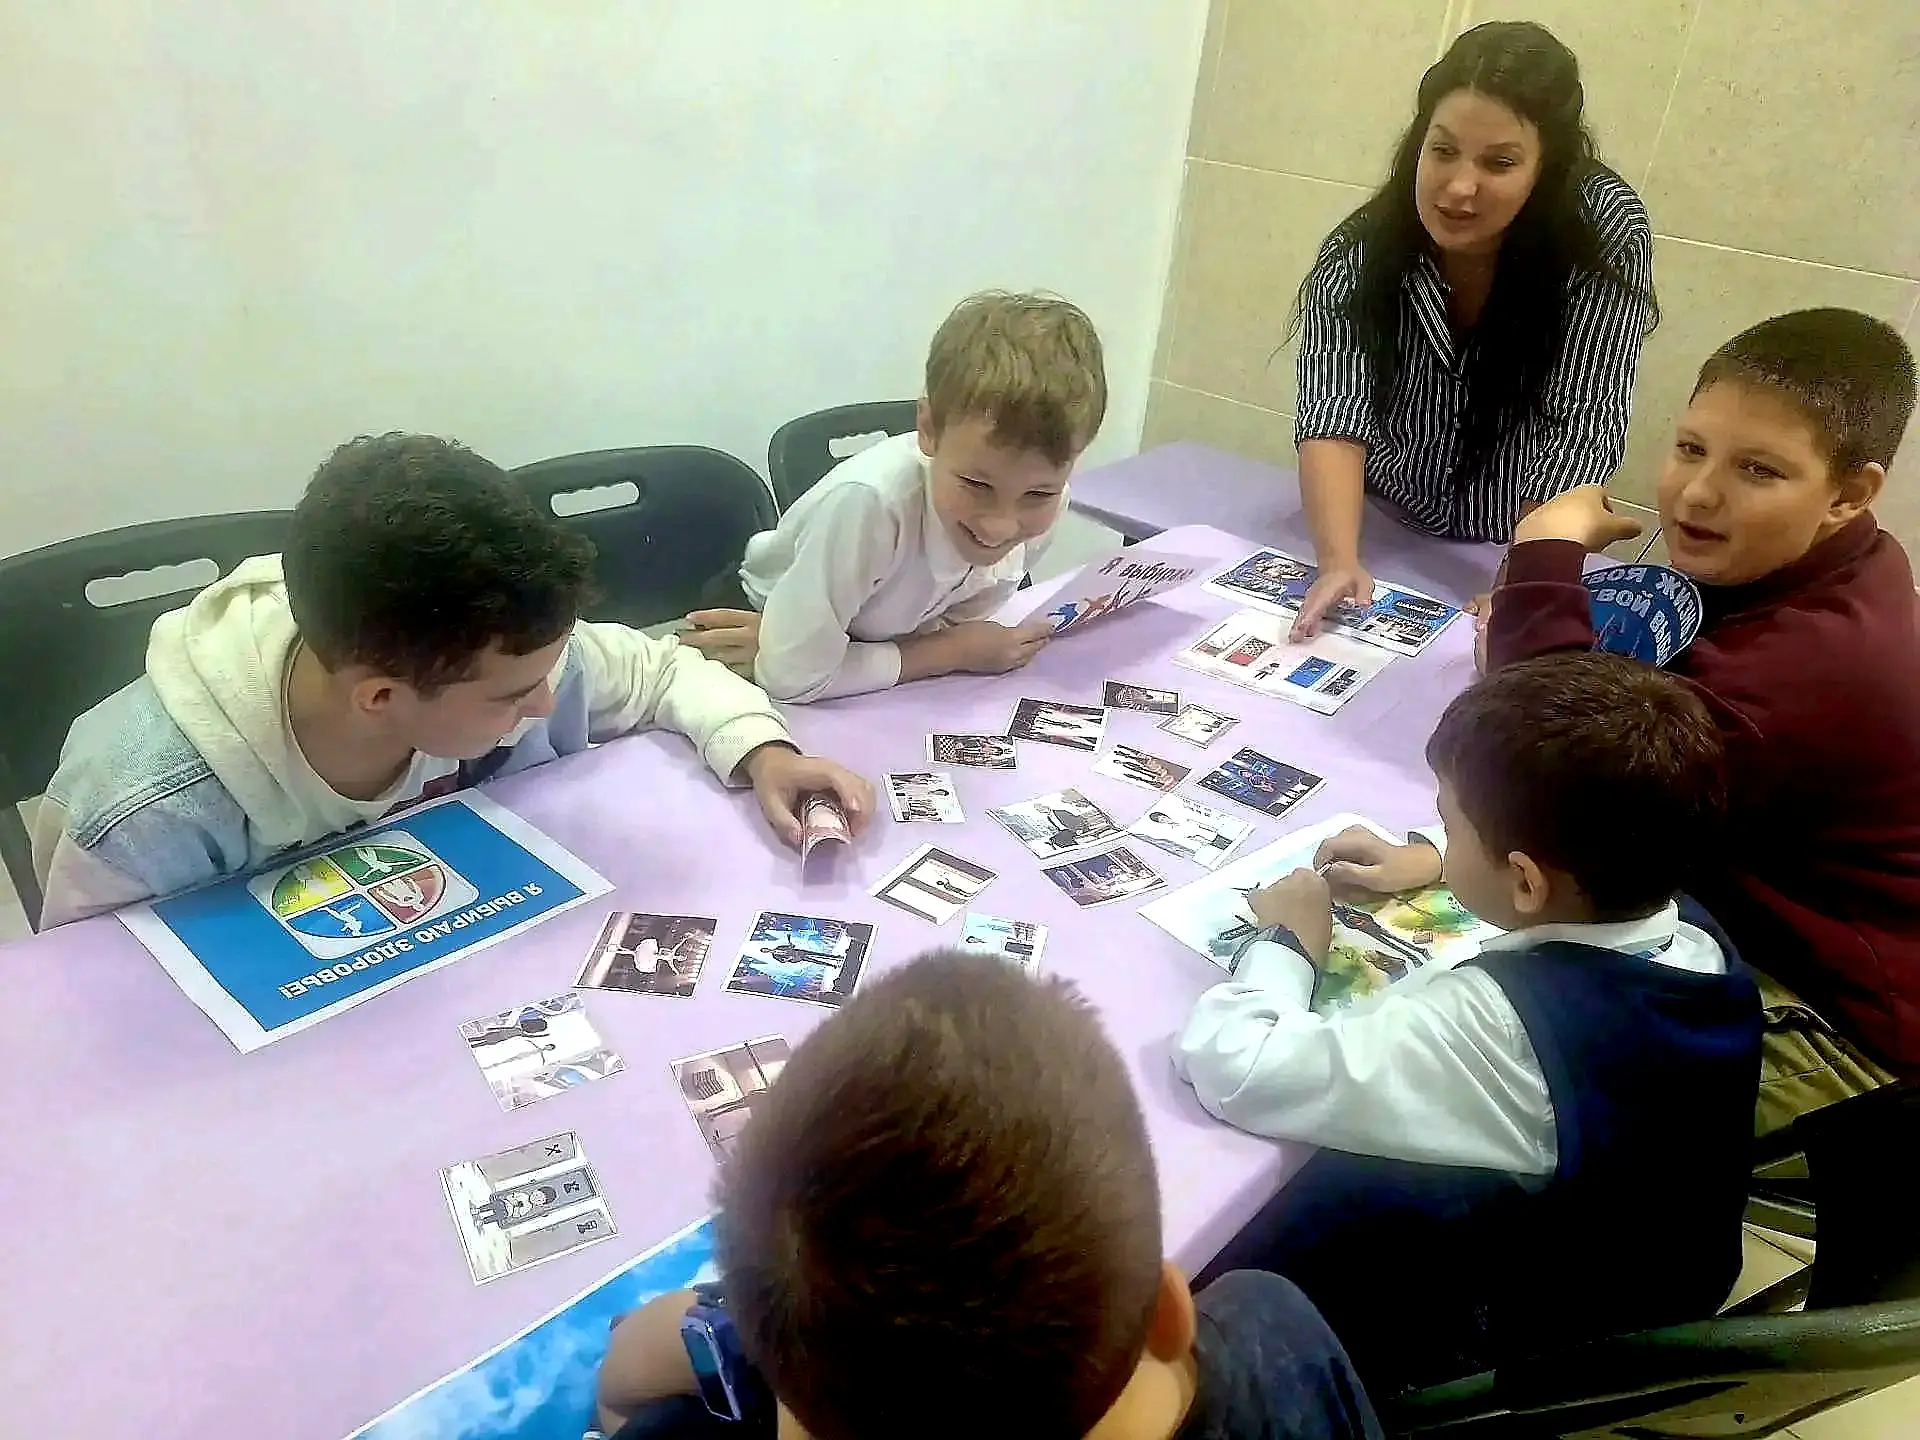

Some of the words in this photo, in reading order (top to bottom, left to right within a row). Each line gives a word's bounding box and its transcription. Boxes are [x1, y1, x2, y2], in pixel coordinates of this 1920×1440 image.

[1099, 556, 1123, 575] Я
[1583, 567, 1647, 585] ВОЯ
[525, 882, 543, 896] Я
[418, 891, 526, 943] ВЫБИРАЮ
[280, 938, 414, 999] ЗДОРОВЬЕ!
